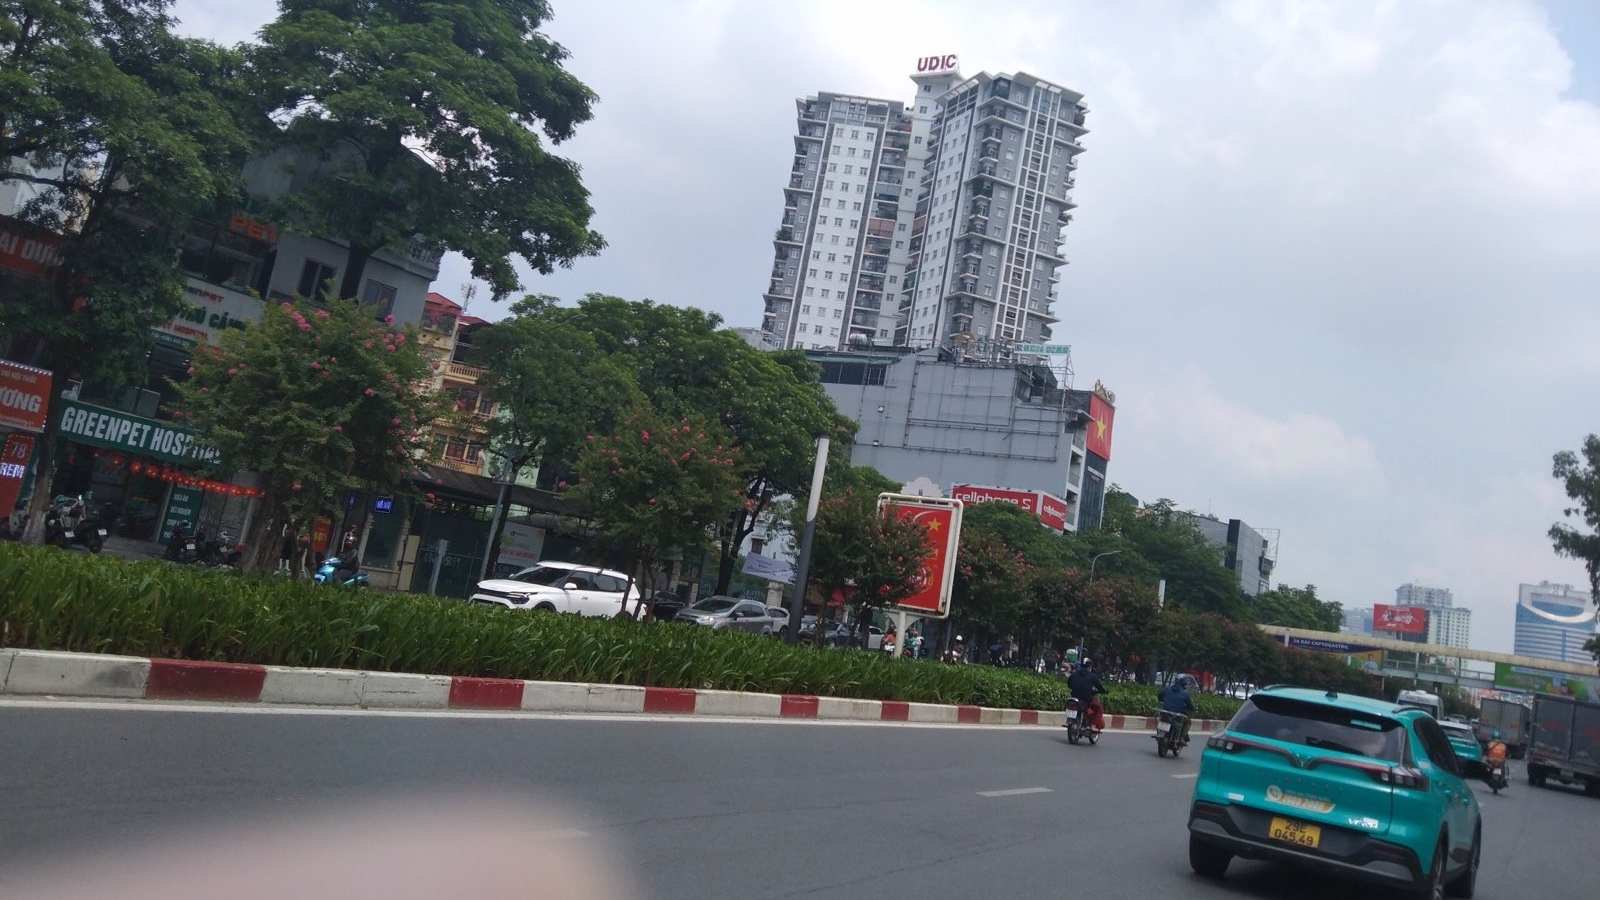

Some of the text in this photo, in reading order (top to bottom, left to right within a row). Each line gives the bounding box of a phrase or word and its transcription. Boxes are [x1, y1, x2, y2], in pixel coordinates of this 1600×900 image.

[917, 54, 956, 72] UDIC
[60, 406, 152, 448] GREENPET
[10, 441, 28, 459] 78
[1284, 819, 1307, 835] 29E
[1274, 829, 1314, 846] 045.49
